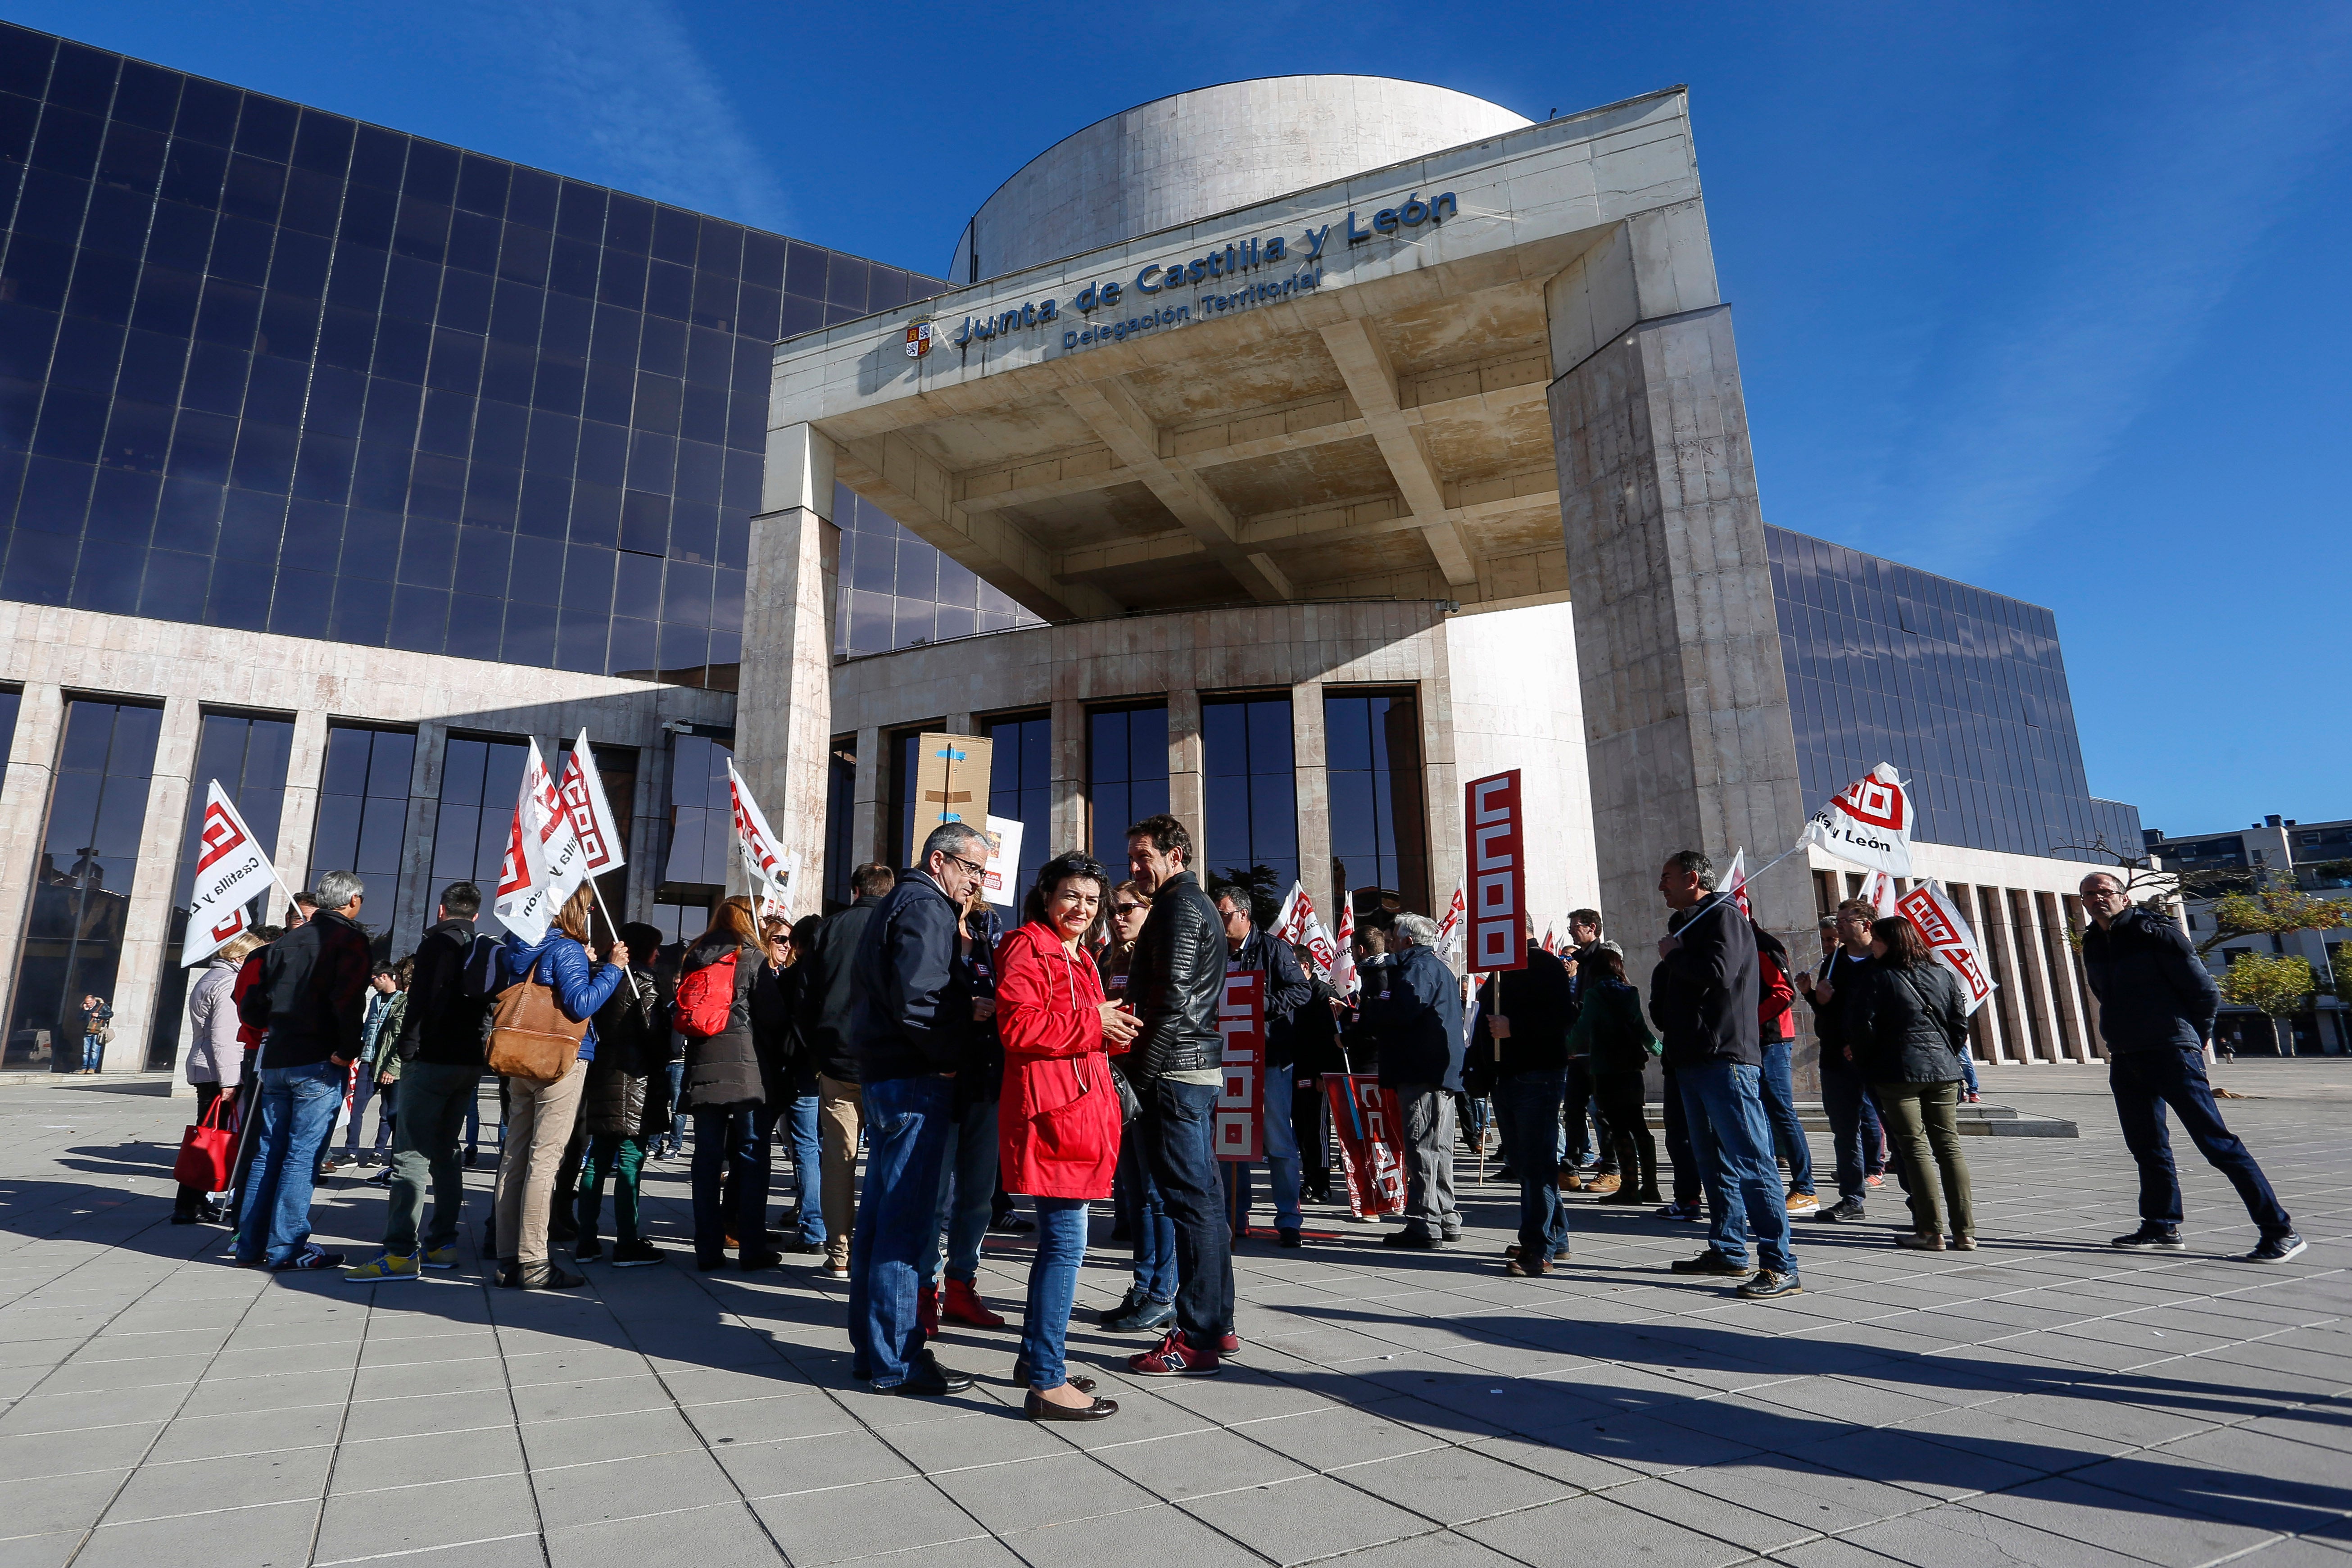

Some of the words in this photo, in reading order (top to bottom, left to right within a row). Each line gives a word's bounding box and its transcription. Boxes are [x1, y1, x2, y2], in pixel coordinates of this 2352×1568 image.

[954, 299, 1058, 345] Junta
[1075, 281, 1122, 313] de
[1136, 236, 1286, 295] Castilla
[1305, 224, 1330, 260] y
[1348, 192, 1458, 242] León
[1064, 304, 1190, 349] Delegación
[1201, 267, 1322, 313] Territorial
[1475, 777, 1515, 967] CCOO
[1811, 811, 1831, 830] illa
[1831, 827, 1840, 838] y
[1846, 829, 1891, 852] León
[1905, 895, 1953, 942] CCOO
[1216, 975, 1253, 1156] CCOO
[1360, 1084, 1405, 1199] CCOO
[1161, 1351, 1187, 1372] N
